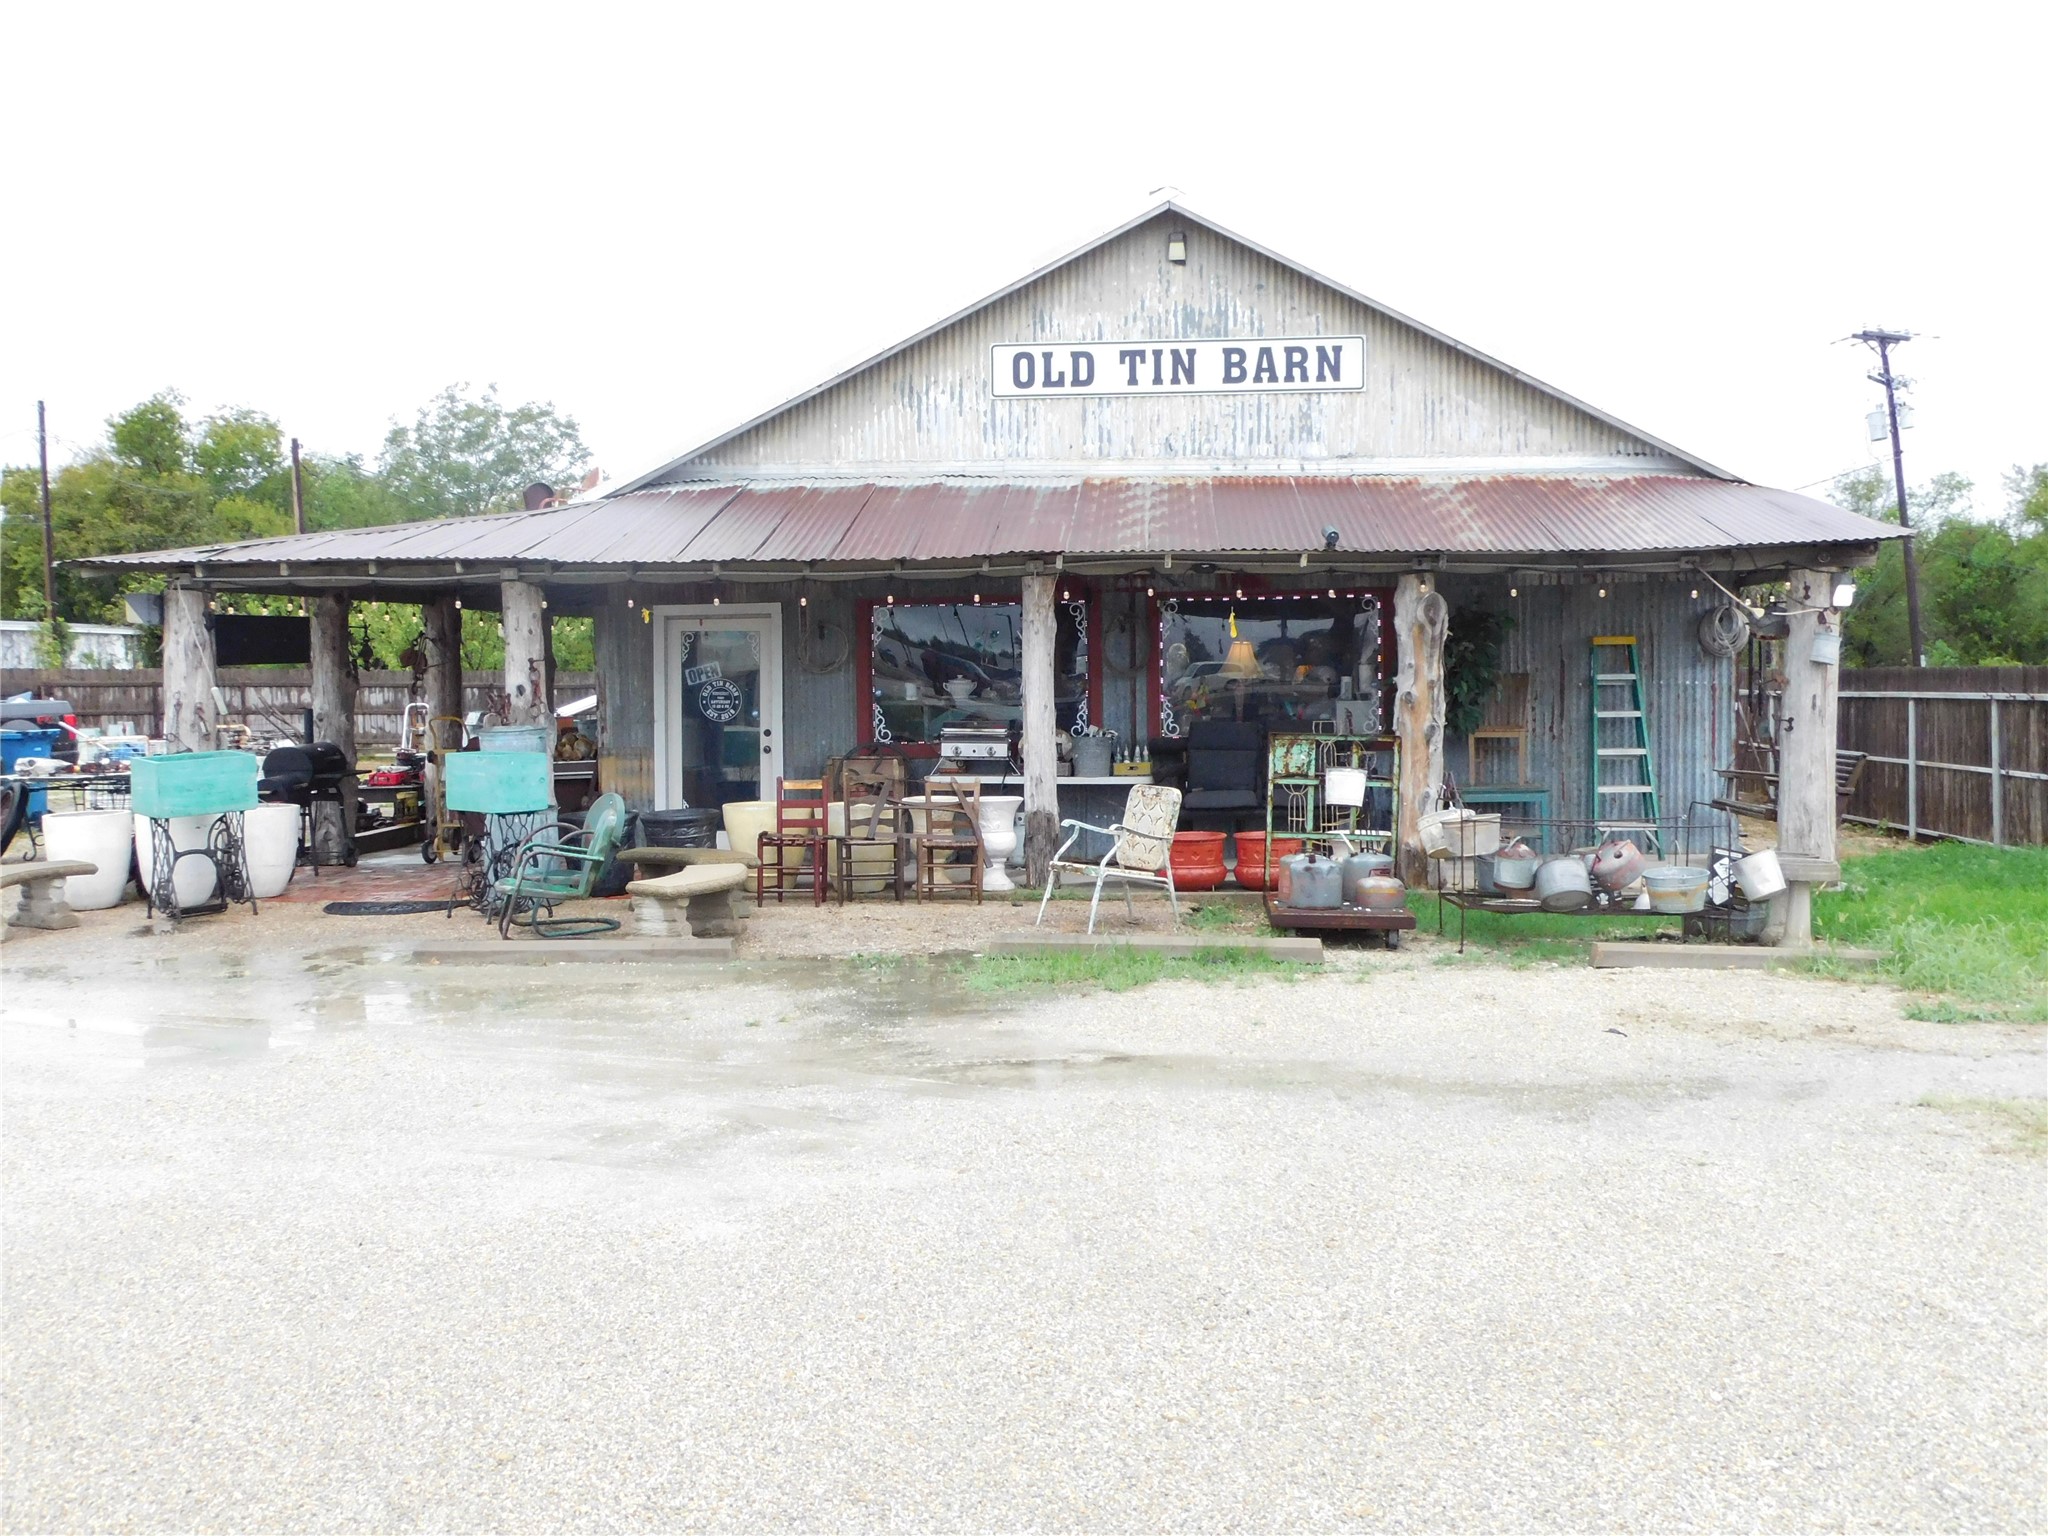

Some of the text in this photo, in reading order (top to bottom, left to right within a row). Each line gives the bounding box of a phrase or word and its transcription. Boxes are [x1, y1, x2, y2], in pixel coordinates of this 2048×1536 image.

[1012, 345, 1343, 389] OLD TIN BARN
[688, 663, 719, 683] OPEN
[702, 685, 712, 697] OLD
[725, 682, 739, 696] BARN
